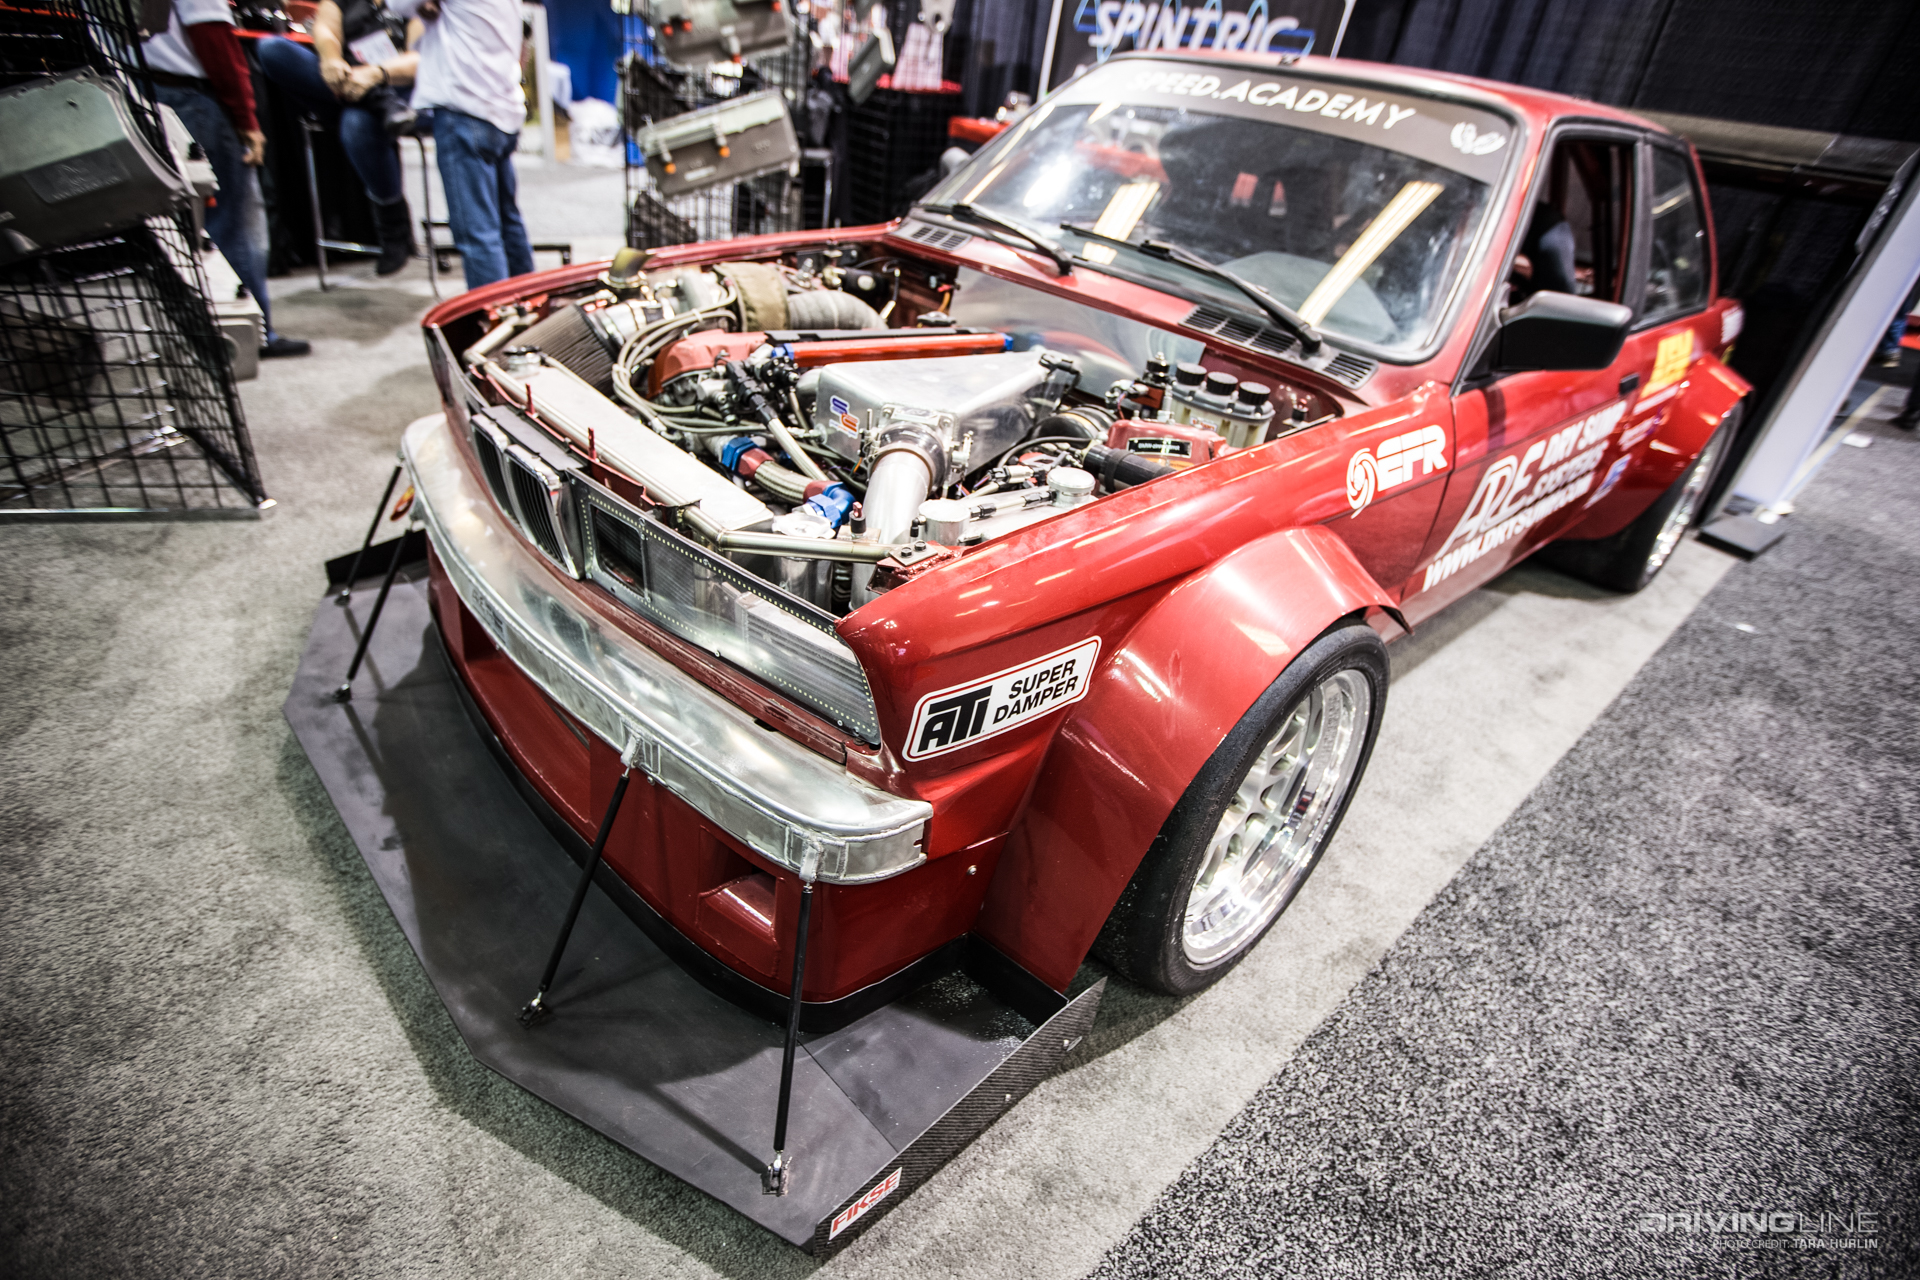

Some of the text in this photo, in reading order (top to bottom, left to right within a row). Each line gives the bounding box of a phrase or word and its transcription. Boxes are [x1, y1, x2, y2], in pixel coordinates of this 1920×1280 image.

[1088, 1, 1299, 53] SPINTRIC
[1127, 71, 1417, 130] SPEED.ACADEMY
[1376, 424, 1448, 492] EFR
[992, 675, 1079, 724] DAMPER
[1008, 659, 1076, 699] SUPER
[917, 685, 994, 753] ATI
[832, 1170, 900, 1233] FIKSE
